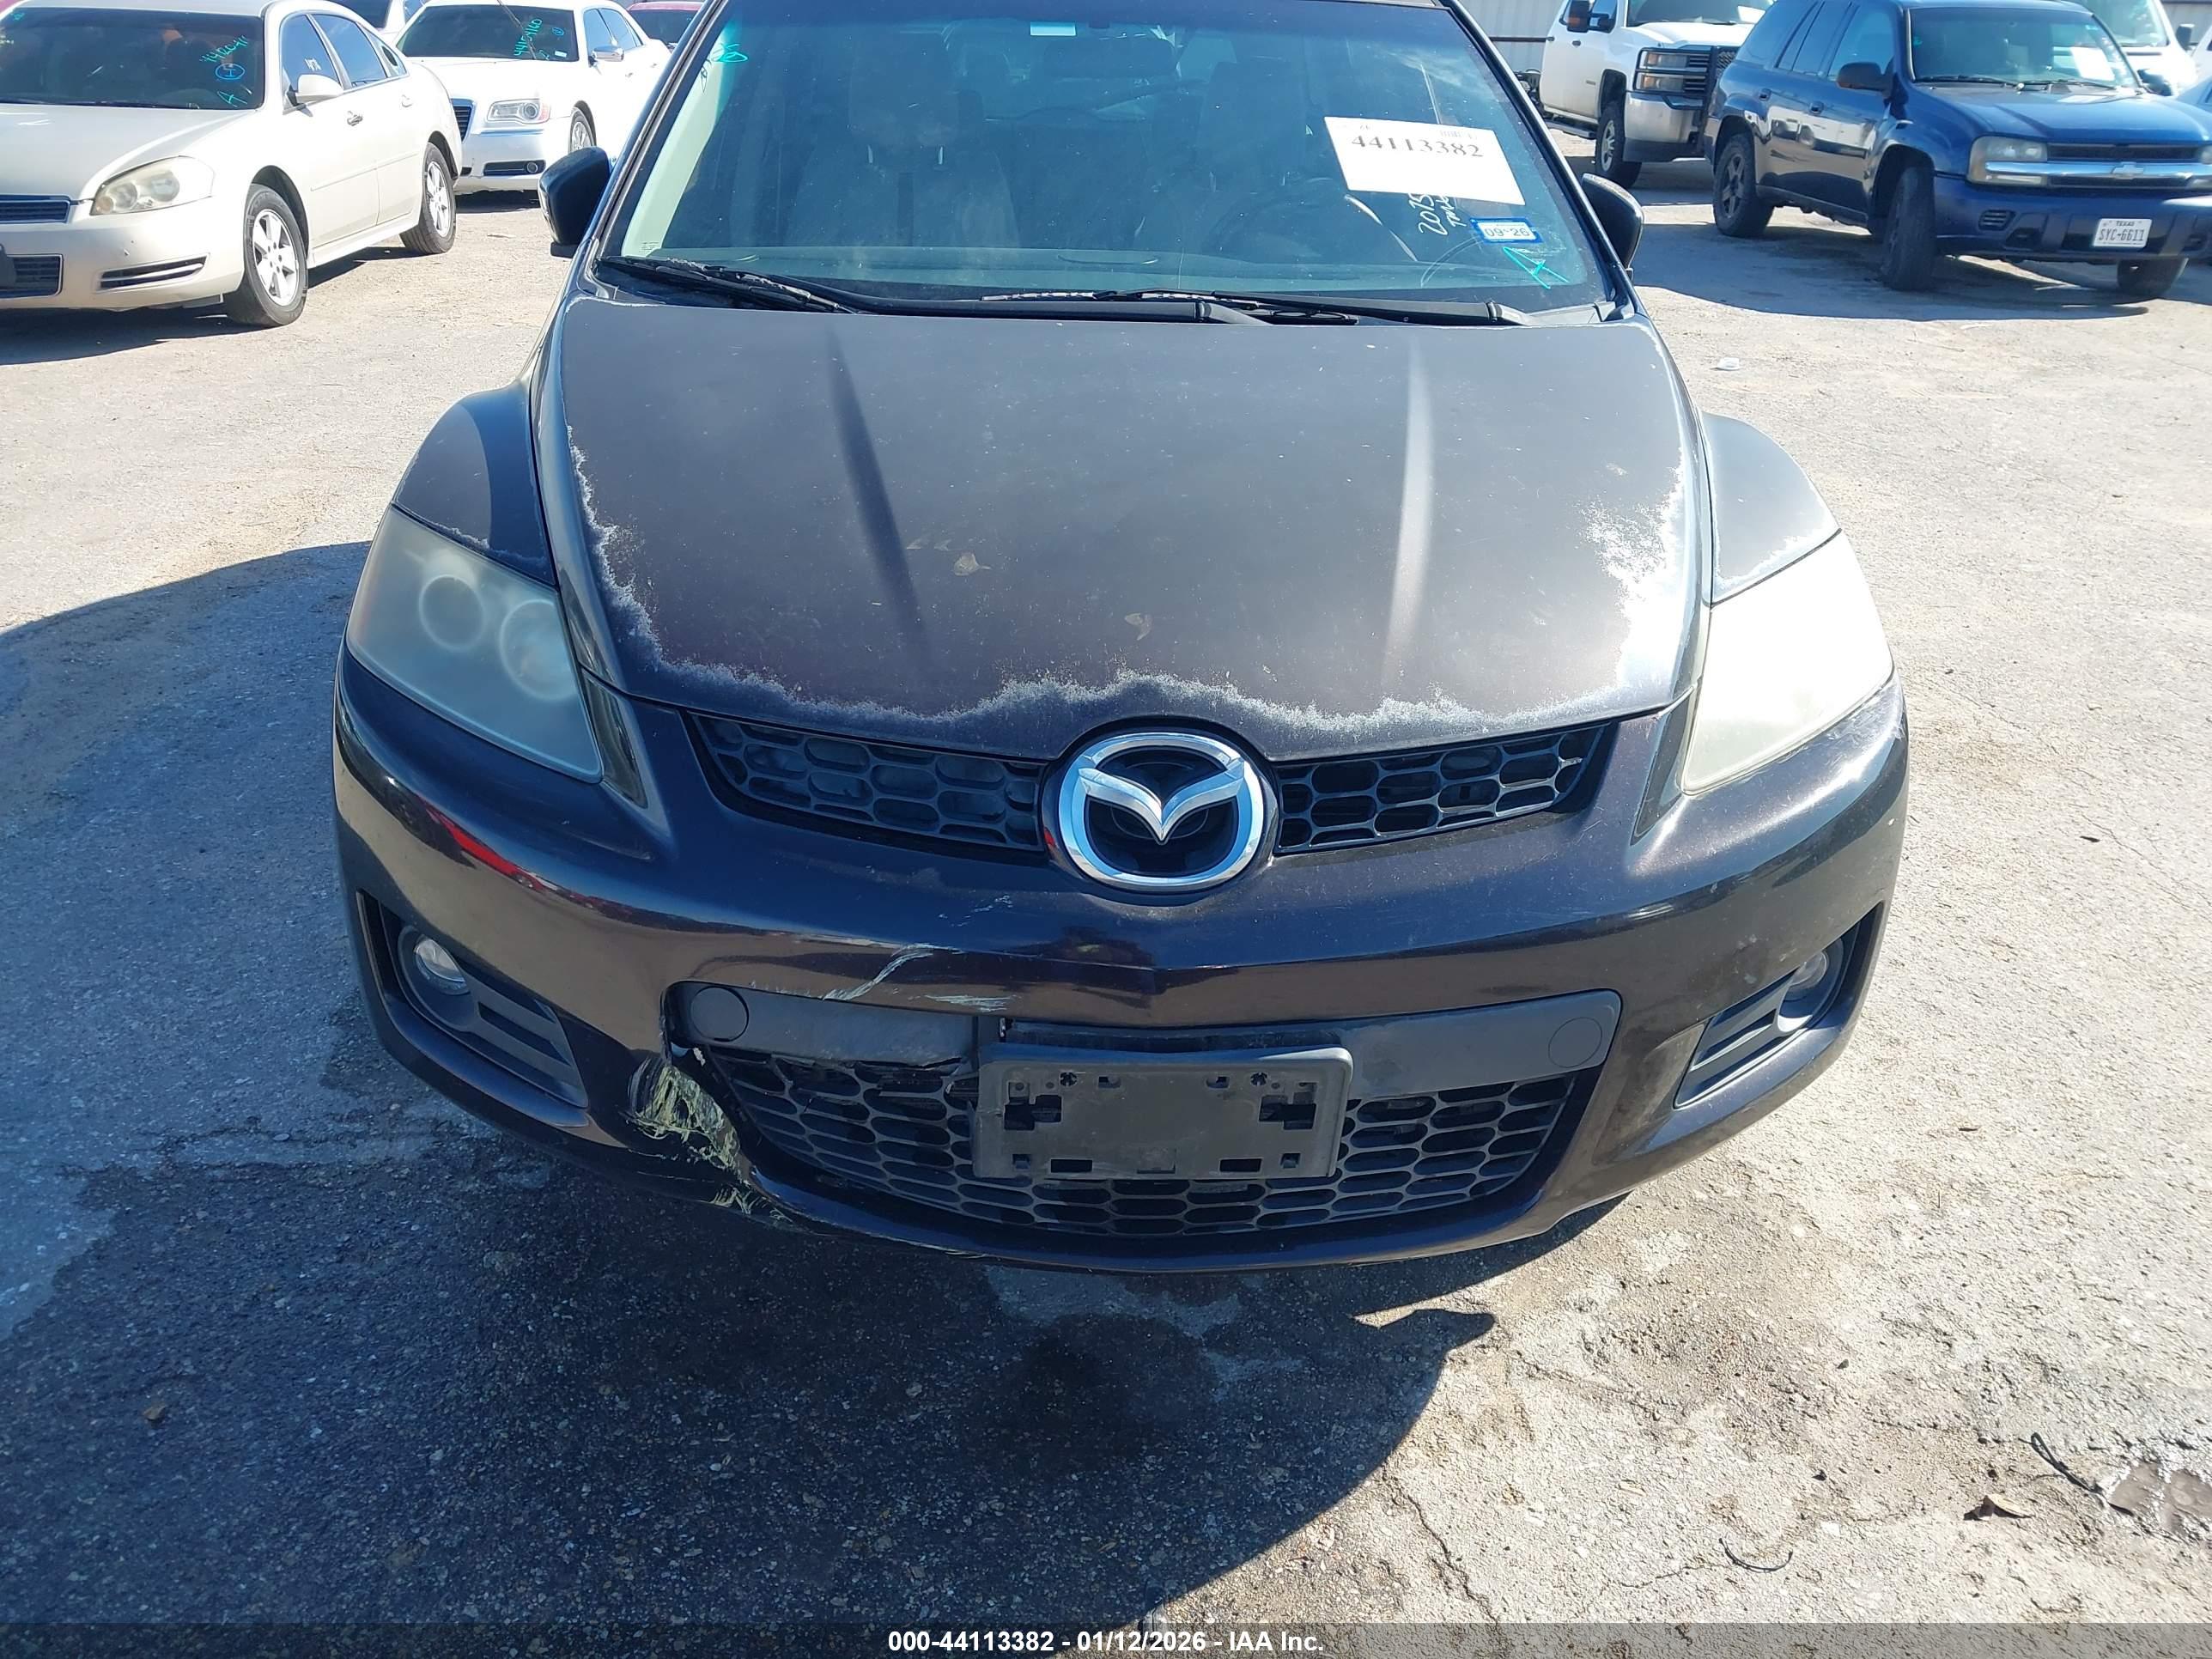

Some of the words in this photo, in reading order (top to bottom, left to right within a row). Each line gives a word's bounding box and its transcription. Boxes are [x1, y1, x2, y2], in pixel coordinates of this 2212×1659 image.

[1352, 135, 1484, 157] 44113382
[1485, 228, 1504, 237] 09
[2099, 228, 2145, 241] SYC-6611
